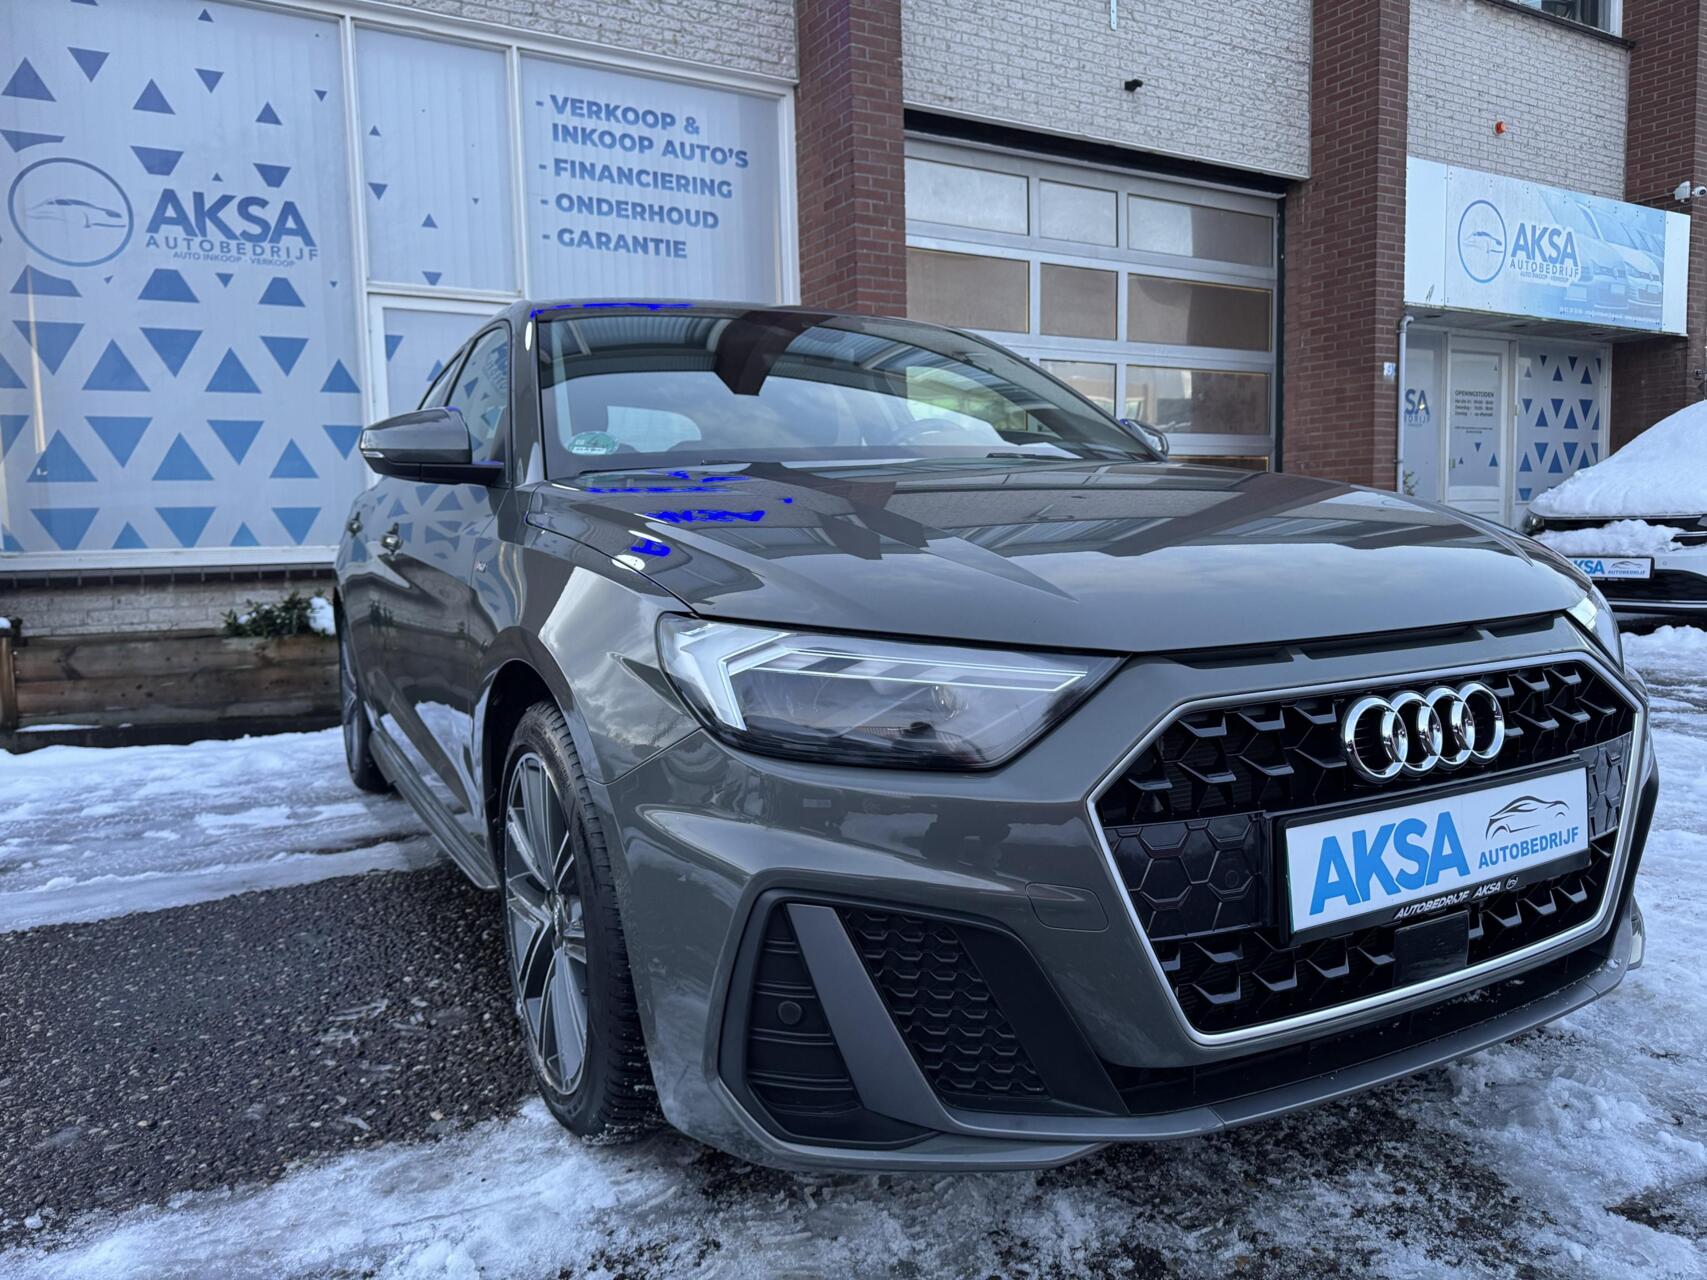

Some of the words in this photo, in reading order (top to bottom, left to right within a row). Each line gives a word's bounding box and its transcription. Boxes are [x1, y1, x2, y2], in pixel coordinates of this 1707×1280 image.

[549, 94, 676, 130] VERKOOP
[683, 116, 700, 135] &
[552, 122, 654, 154] INKOOP
[661, 139, 749, 169] AUTO'S
[553, 157, 733, 199] FINANCIERING
[145, 188, 317, 247] AKSA
[555, 193, 719, 229] ONDERHOUD
[145, 235, 318, 262] AUTOBEDRIJF
[173, 251, 200, 260] AUTO
[203, 253, 242, 263] INKOOP
[250, 257, 296, 268] VERKOOP
[557, 228, 688, 259] GARANTIE
[1511, 223, 1578, 267] AKSA
[1510, 258, 1579, 278] AUTOBEDRIJF
[1405, 388, 1430, 415] SA
[1309, 811, 1470, 916] AKSA
[1478, 826, 1579, 869] AUTOBEDRIJF
[1393, 891, 1469, 919] AUTOBEDRIJF
[1473, 880, 1501, 898] AKSA
